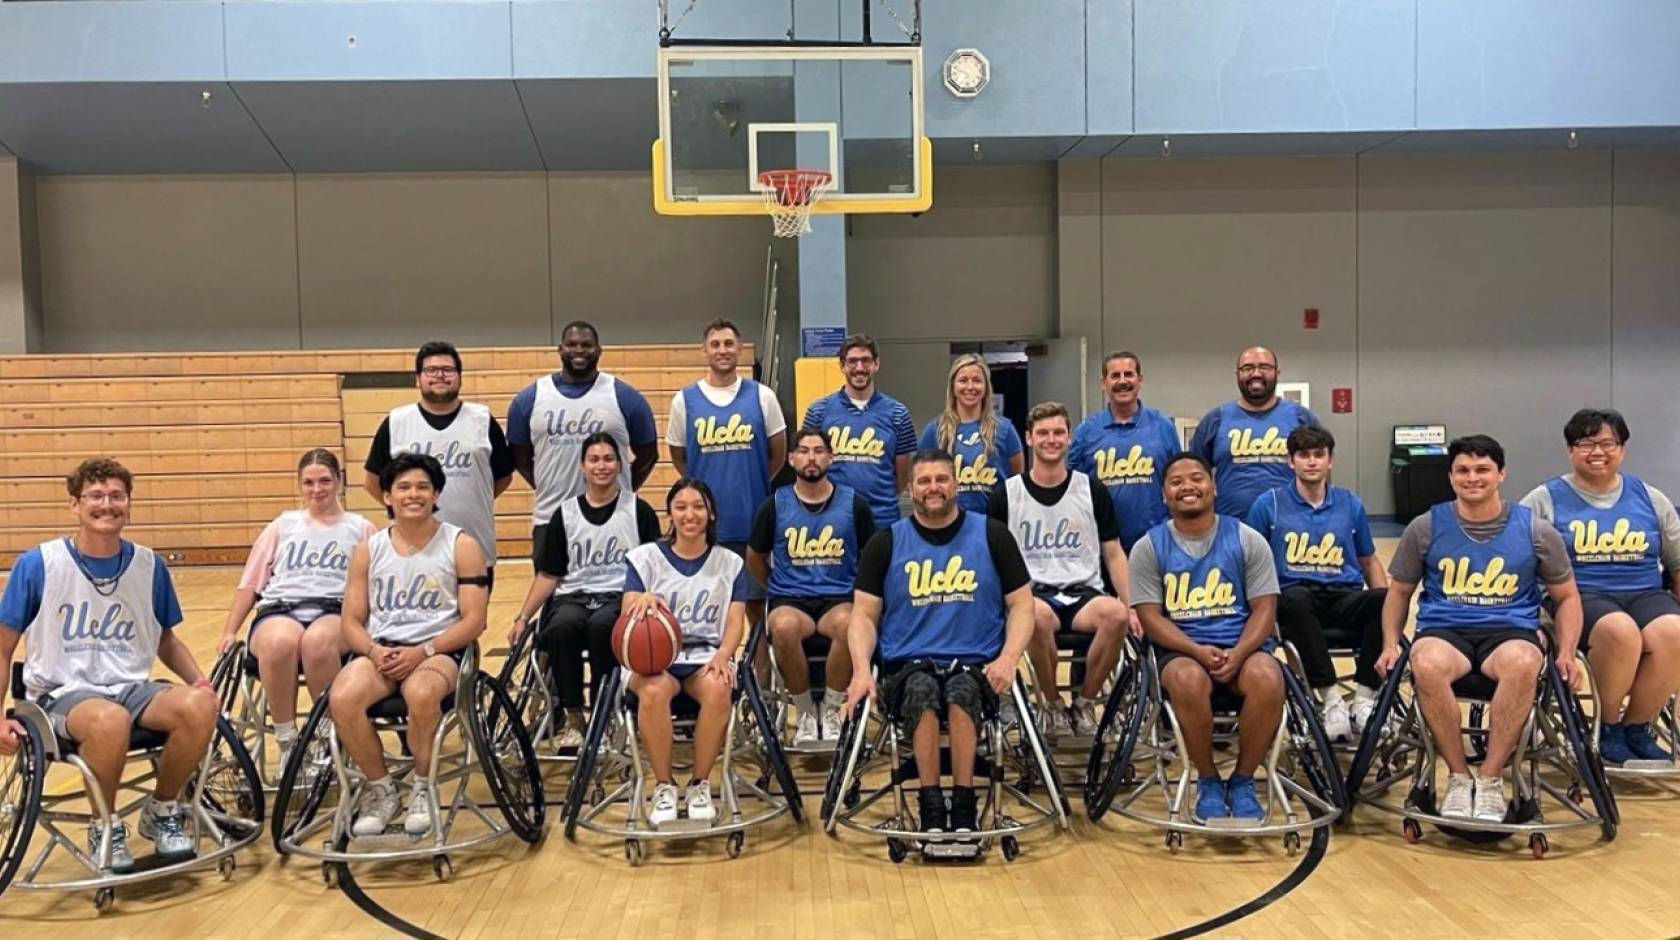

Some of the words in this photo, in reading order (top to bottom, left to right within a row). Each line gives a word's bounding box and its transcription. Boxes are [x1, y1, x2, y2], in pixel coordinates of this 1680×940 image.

[693, 413, 754, 446] Ucla
[828, 426, 885, 457] Ucla
[1094, 444, 1154, 479] Ucla
[784, 524, 845, 558] Ucla
[1020, 518, 1081, 550] Ucla
[1284, 531, 1344, 566] Ucla
[1569, 518, 1650, 554] Ucla
[286, 540, 347, 570] Ucla
[375, 574, 442, 611] Ucla
[904, 555, 978, 597] Ucla
[1164, 567, 1236, 611] Ucla
[1438, 557, 1519, 596] Ucla
[59, 601, 135, 640] Ucla
